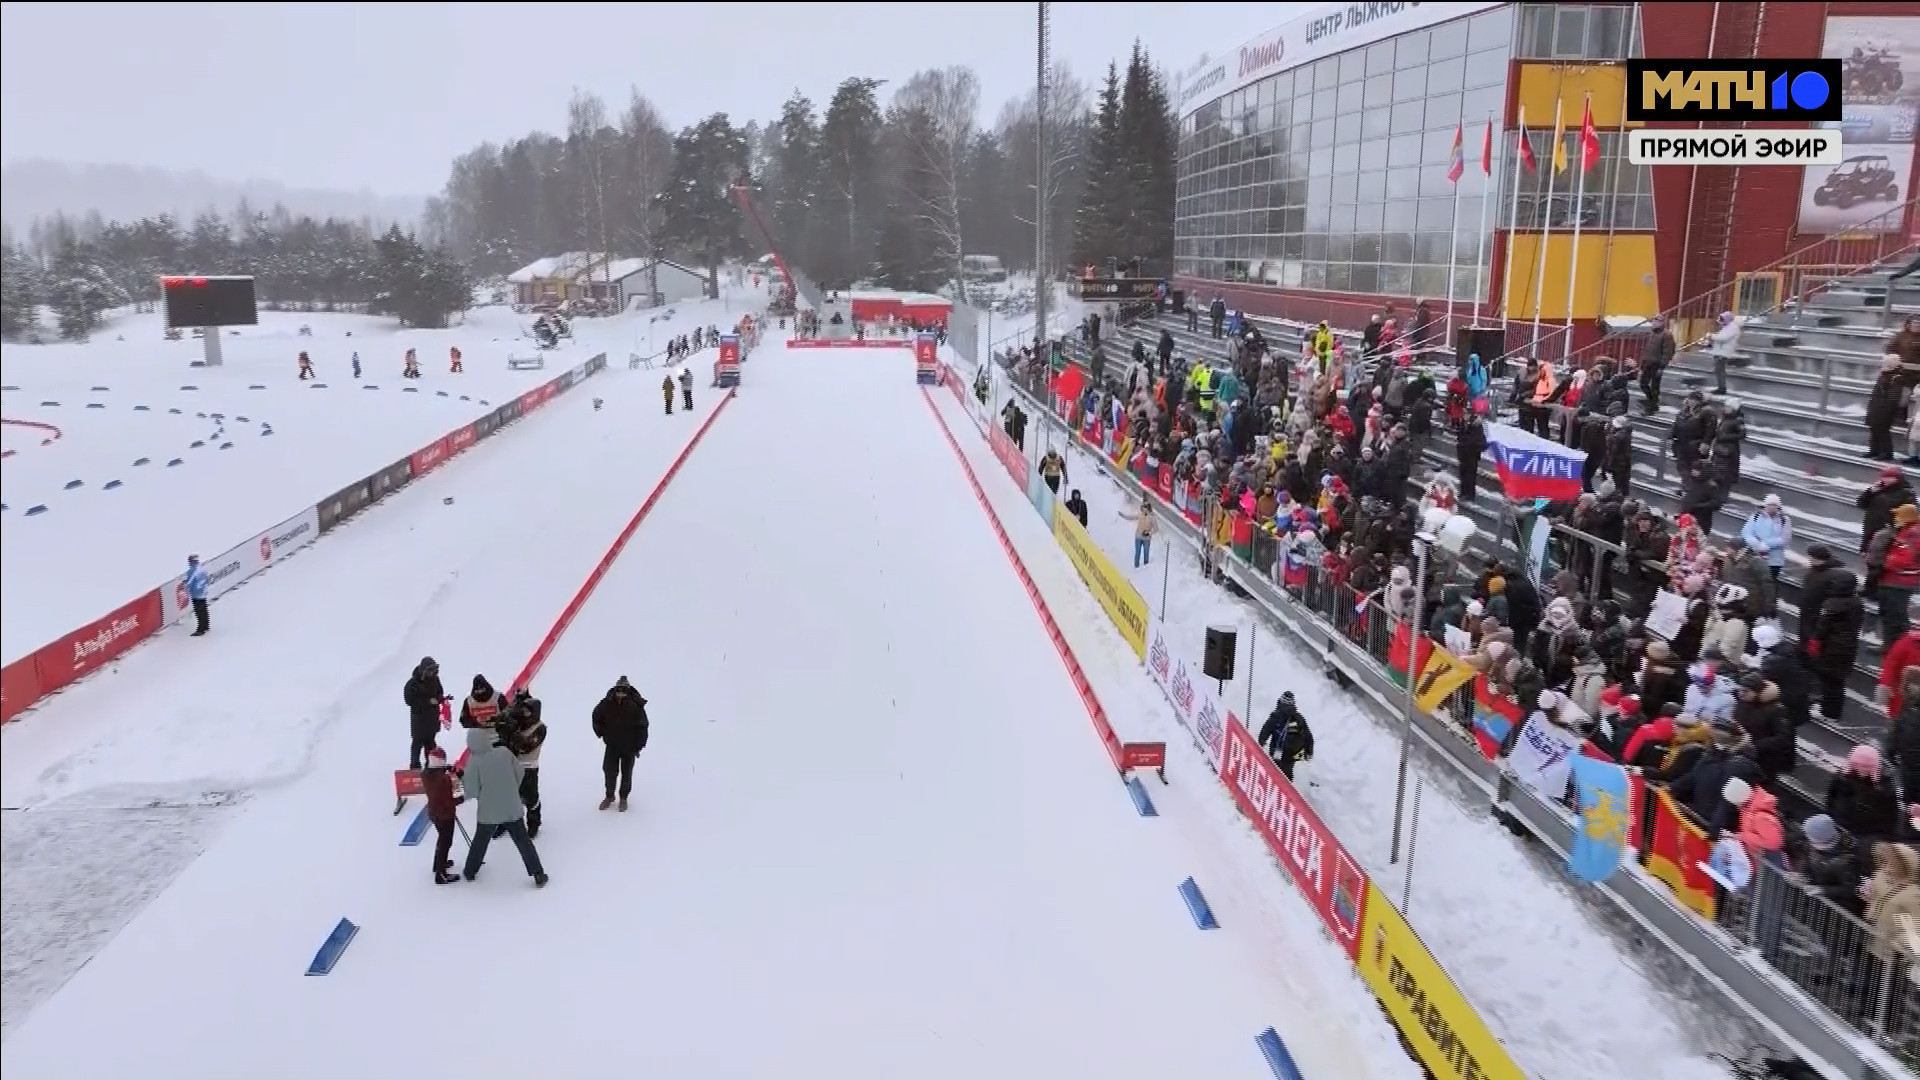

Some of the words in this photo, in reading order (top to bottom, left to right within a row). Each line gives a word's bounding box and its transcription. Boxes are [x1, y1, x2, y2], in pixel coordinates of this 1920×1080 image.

[1305, 12, 1342, 44] ЦЕНТР
[1344, 3, 1419, 30] ЛЫЖН
[207, 560, 242, 586] ОНИКОЛЬ
[74, 626, 114, 661] Альфа
[113, 612, 141, 639] Банк
[1117, 598, 1142, 639] ОБЛАСТИ
[1227, 732, 1325, 895] РЫБИНСК
[1388, 953, 1488, 1079] ПРАВИТЕ
